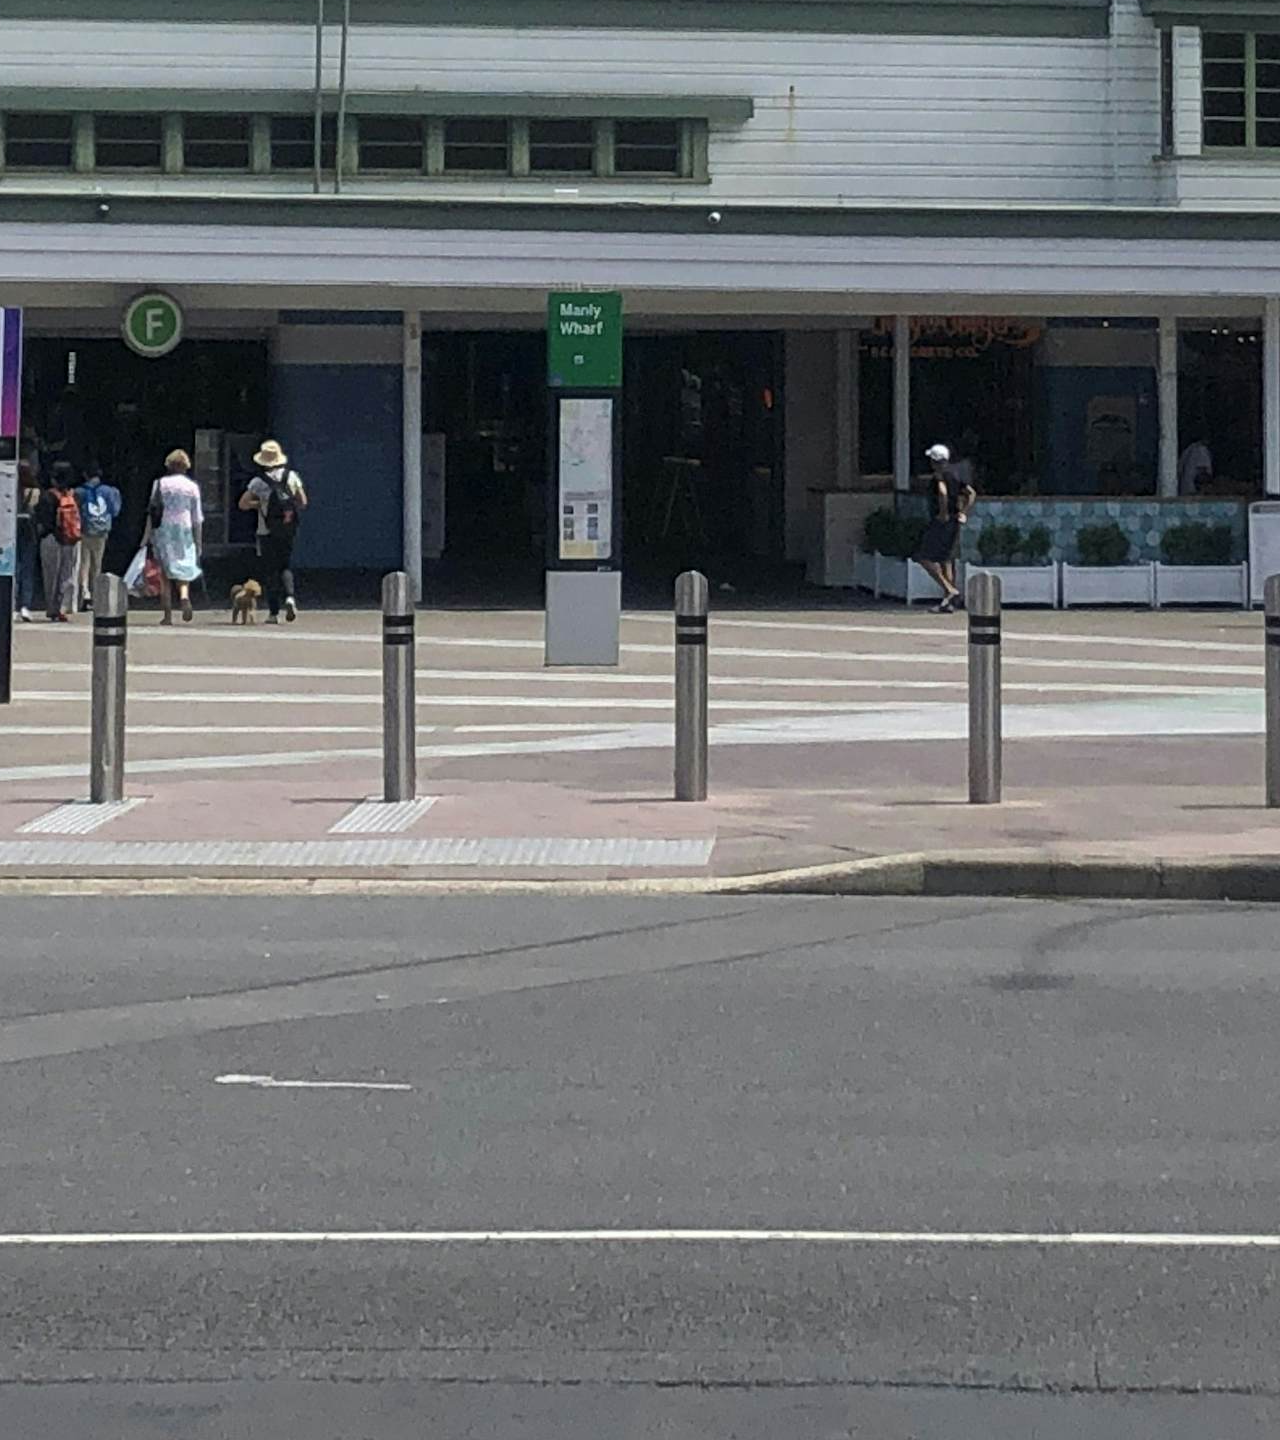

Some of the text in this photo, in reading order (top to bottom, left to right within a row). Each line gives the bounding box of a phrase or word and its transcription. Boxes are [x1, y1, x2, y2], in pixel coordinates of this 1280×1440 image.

[559, 303, 602, 320] Manly
[145, 307, 164, 340] F
[559, 321, 604, 335] Wharf
